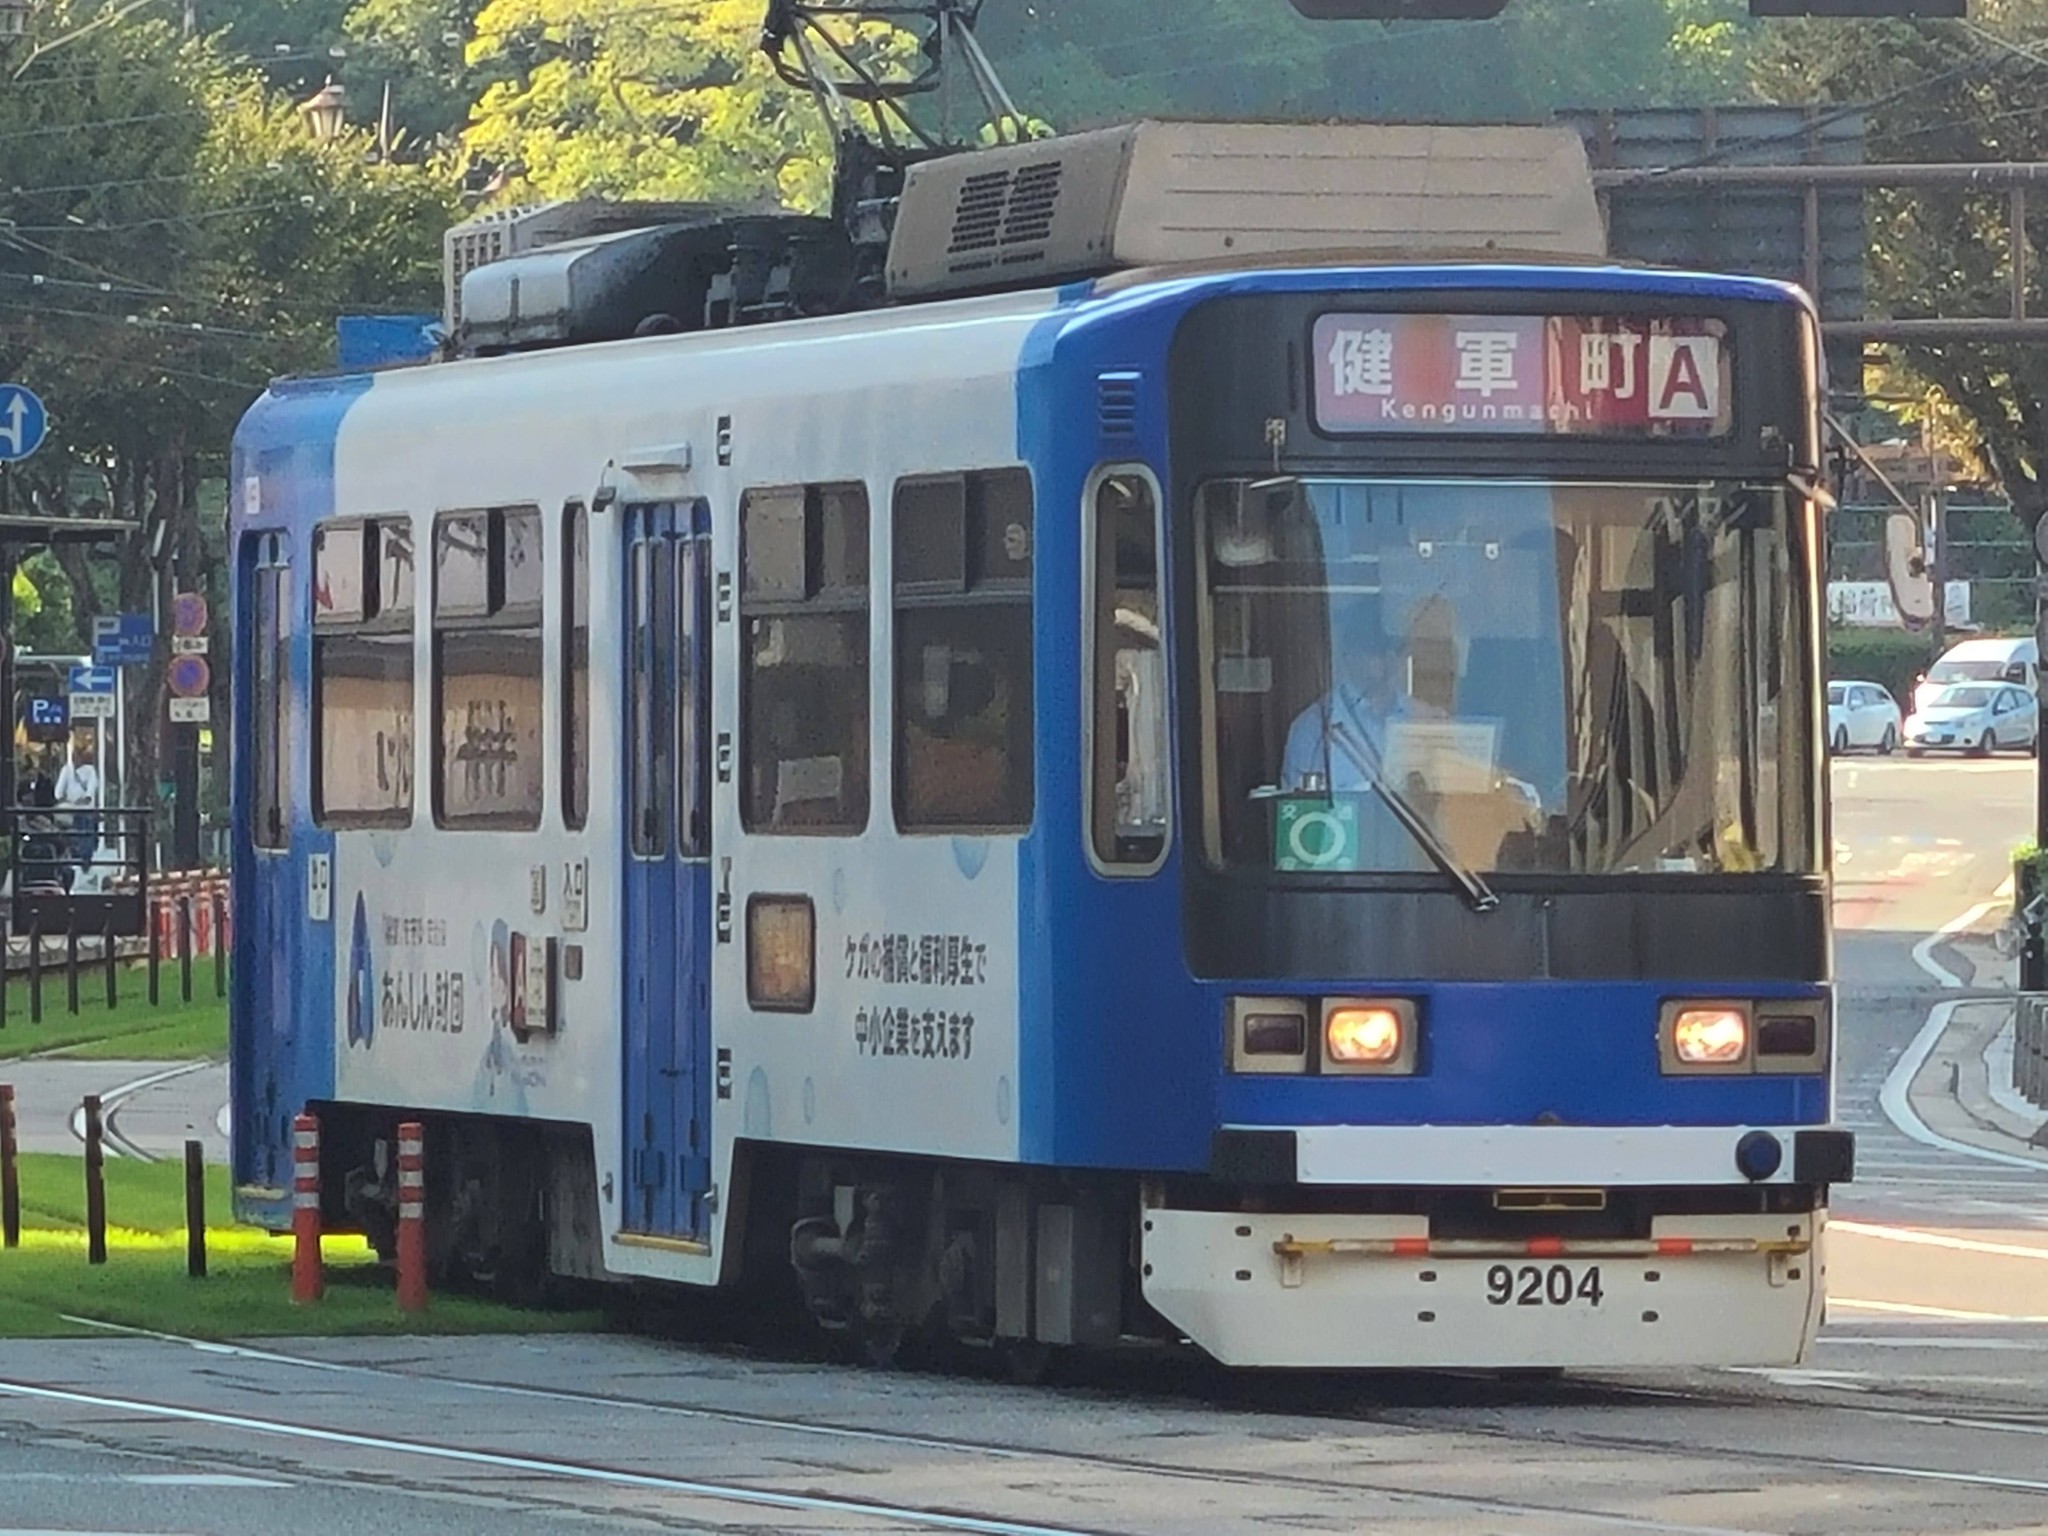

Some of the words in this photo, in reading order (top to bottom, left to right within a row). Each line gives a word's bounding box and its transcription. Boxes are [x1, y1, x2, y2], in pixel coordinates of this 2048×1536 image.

[1659, 343, 1709, 410] A
[1381, 398, 1594, 422] Kengunmachi
[1486, 1264, 1604, 1306] 9204
